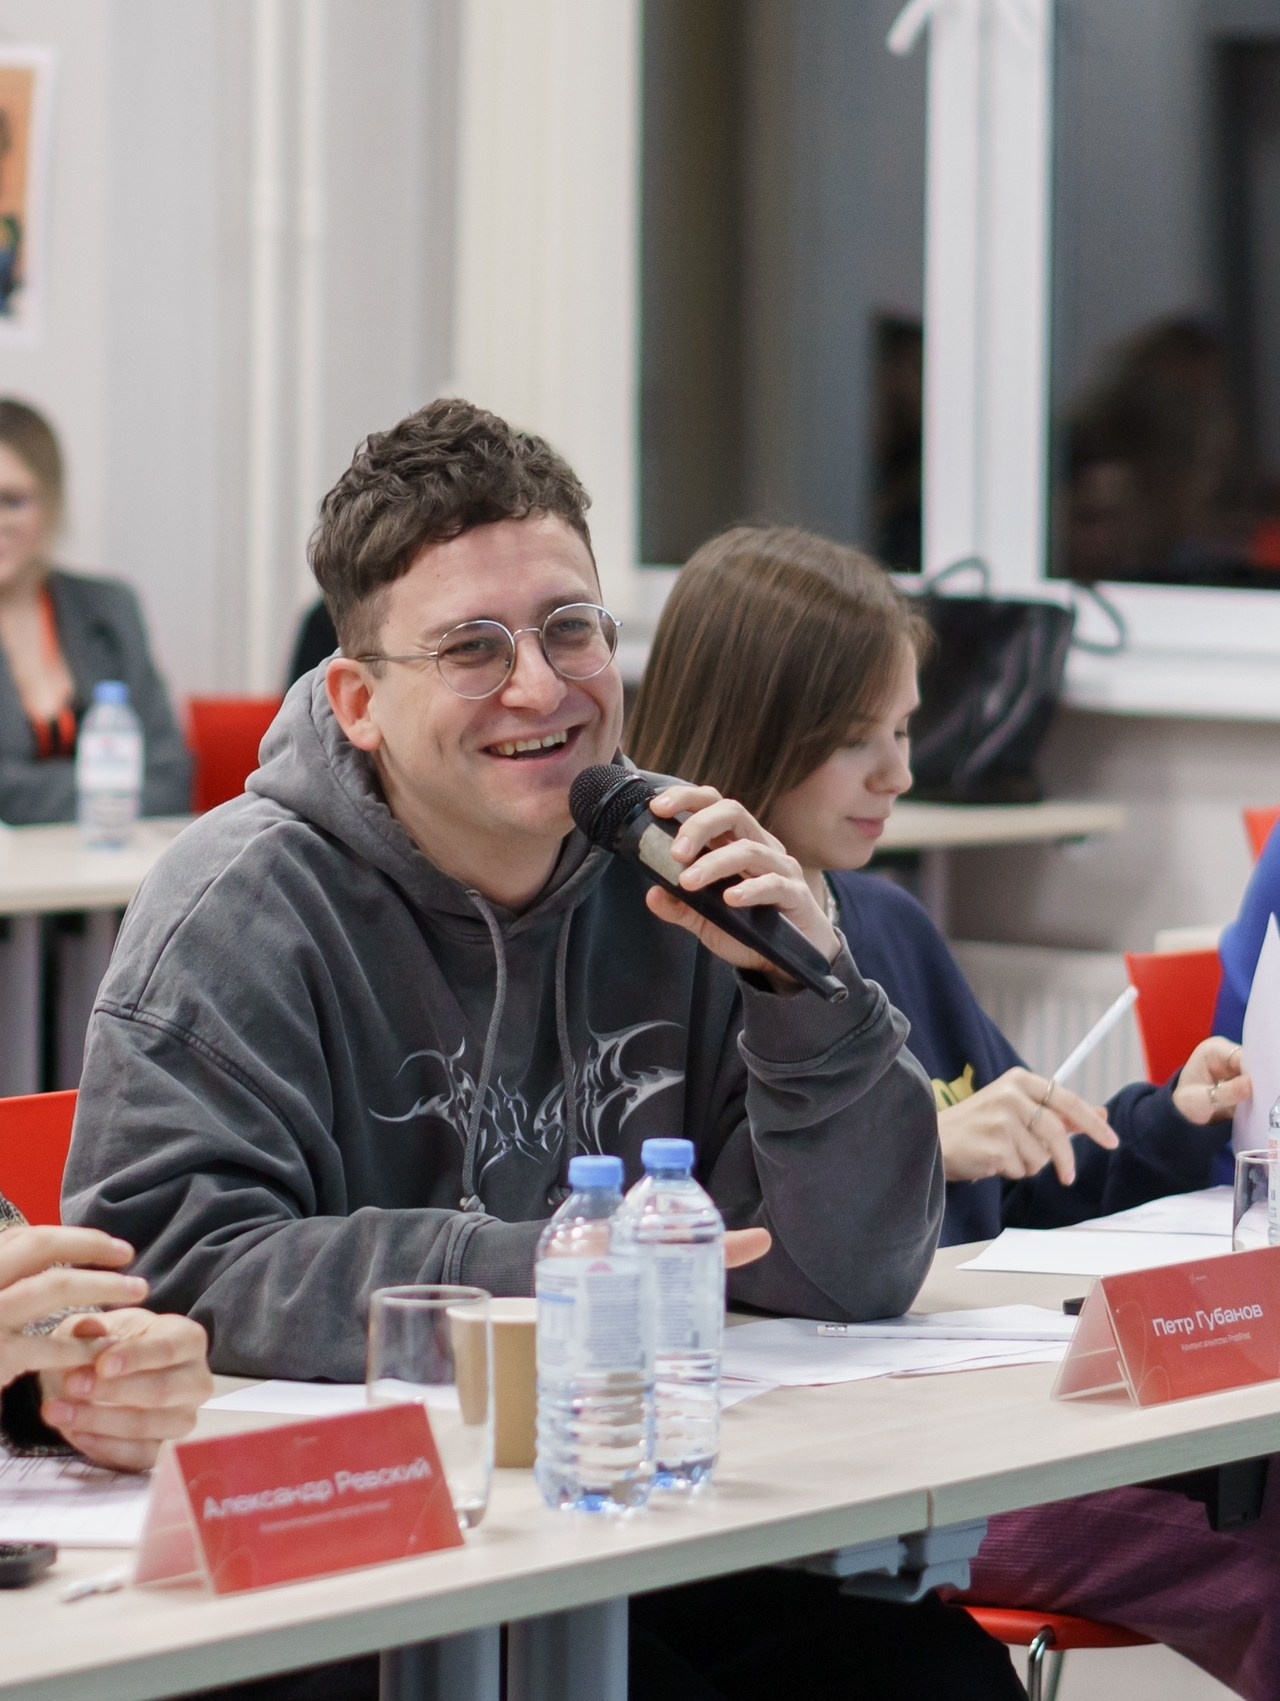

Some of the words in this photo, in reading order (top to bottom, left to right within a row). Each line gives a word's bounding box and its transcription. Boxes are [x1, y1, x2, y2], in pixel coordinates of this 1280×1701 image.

[1152, 1317, 1195, 1336] Петр
[1196, 1303, 1263, 1331] Губанов
[204, 1478, 334, 1519] Александр
